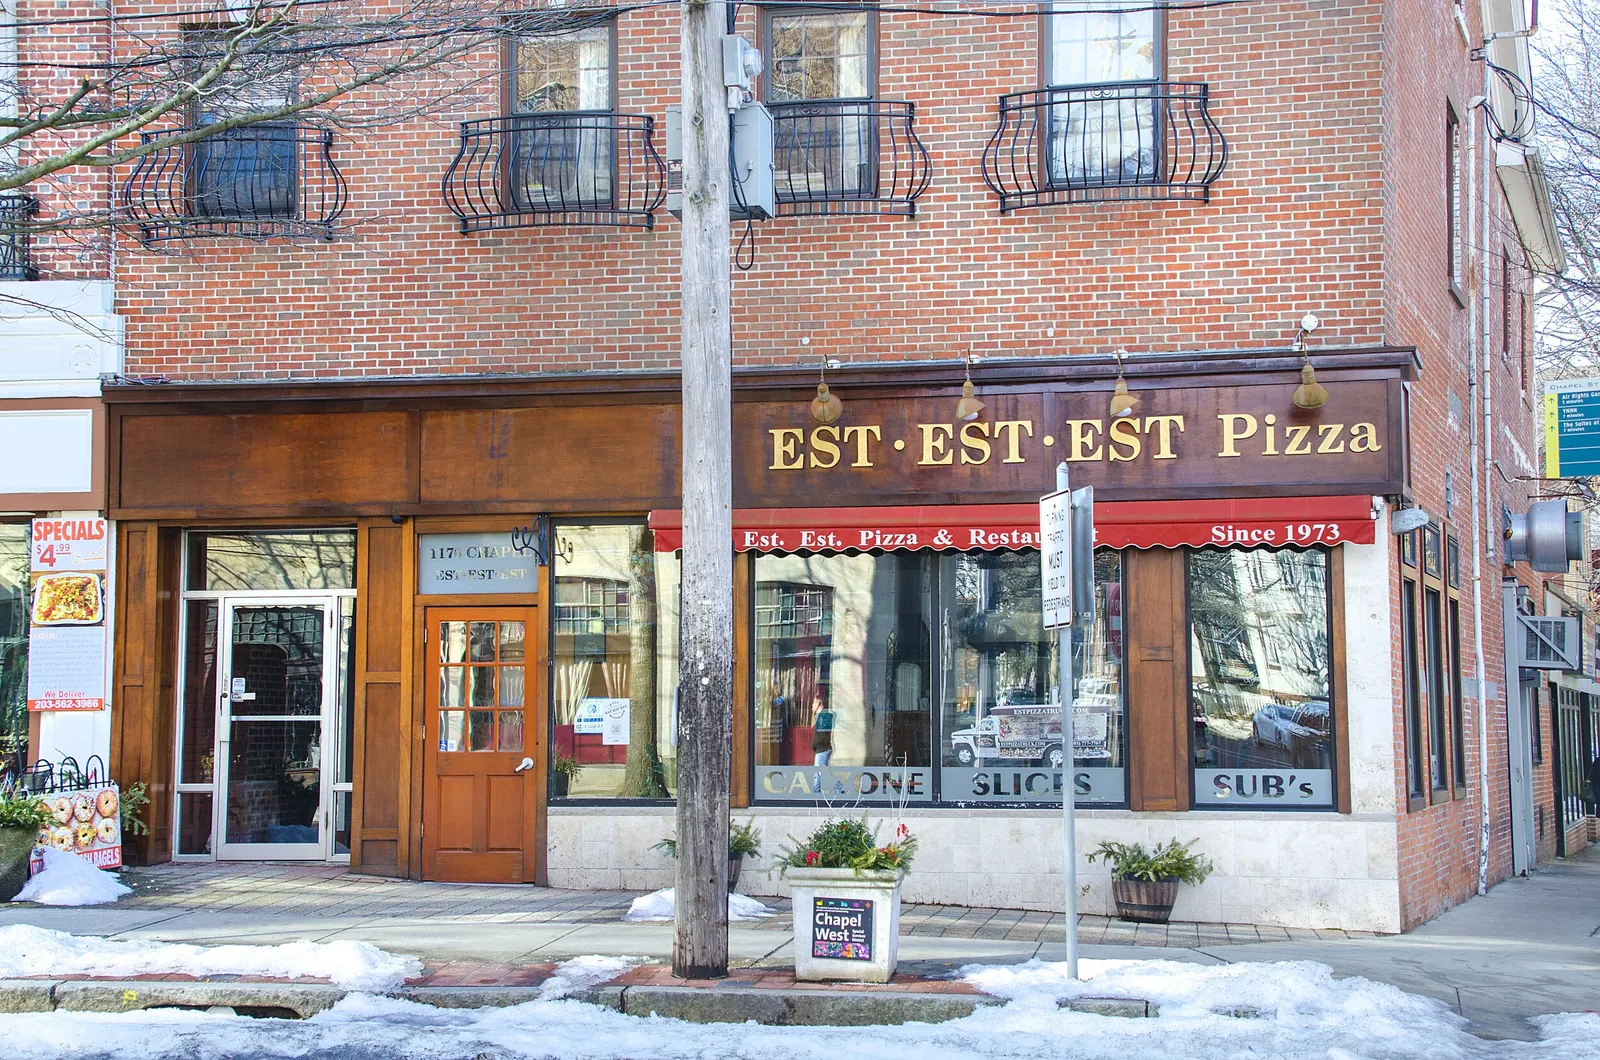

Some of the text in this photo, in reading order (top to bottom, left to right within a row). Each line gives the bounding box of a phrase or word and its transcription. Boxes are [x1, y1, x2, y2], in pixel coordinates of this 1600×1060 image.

[769, 413, 1382, 469] EST EST EST Pizza
[34, 520, 104, 541] SPECIALS
[743, 528, 1099, 547] Est. Est. Pizza & Restaut
[1211, 523, 1340, 542] Since 1973
[430, 545, 533, 560] 1176 CHAPEL
[1048, 551, 1063, 569] MUST
[44, 690, 86, 699] We Deliver
[1013, 706, 1089, 715] ESTPIZZATRUCOM
[763, 771, 924, 795] CALZONE
[972, 772, 1092, 796] SLICES
[1213, 774, 1314, 799] SUB's
[94, 847, 120, 867] BAGELS
[815, 912, 862, 930] Chapel
[815, 927, 849, 942] West
